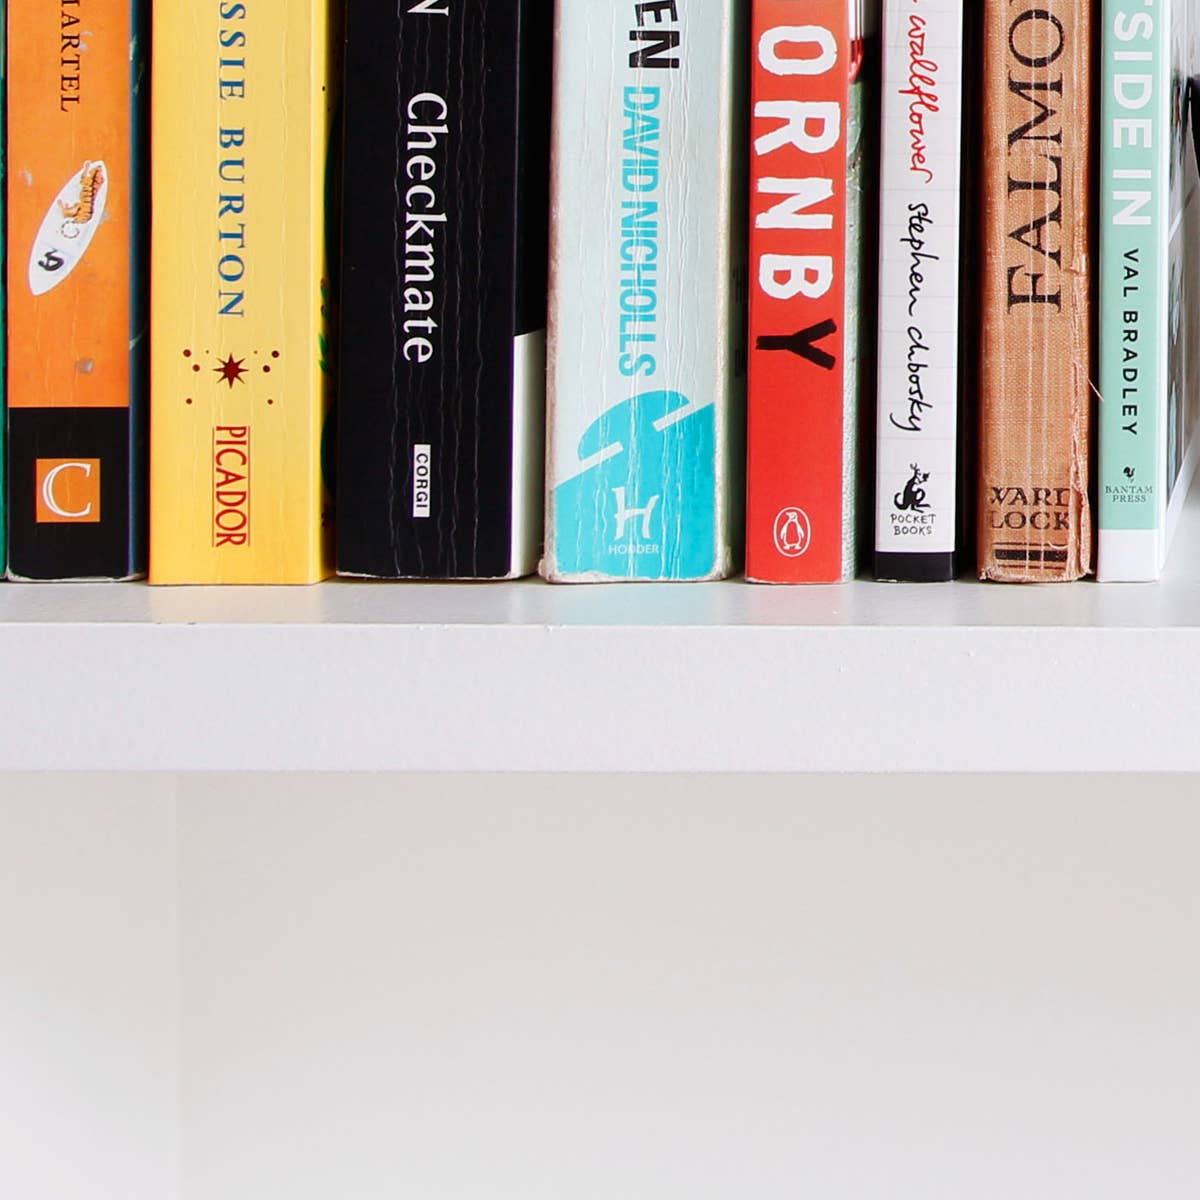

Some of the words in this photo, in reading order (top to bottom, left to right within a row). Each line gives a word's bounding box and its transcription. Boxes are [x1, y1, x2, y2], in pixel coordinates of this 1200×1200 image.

[897, 14, 940, 184] wallflower
[621, 85, 661, 193] DAVID
[217, 126, 246, 318] BURTON
[1112, 169, 1152, 226] IN
[403, 92, 449, 364] Checkmate
[617, 200, 658, 378] NICHOLLS
[1123, 248, 1140, 298] VAL
[1121, 310, 1138, 436] BRADLEY
[41, 462, 92, 517] C
[214, 425, 248, 547] PICADOR
[415, 452, 429, 510] CORGI
[1104, 485, 1153, 495] BANTAM
[1112, 494, 1147, 504] PRESS
[890, 513, 936, 526] POCKET
[893, 524, 933, 537] BOOKS
[989, 511, 1070, 531] LOCK
[608, 543, 660, 556] HODDER
